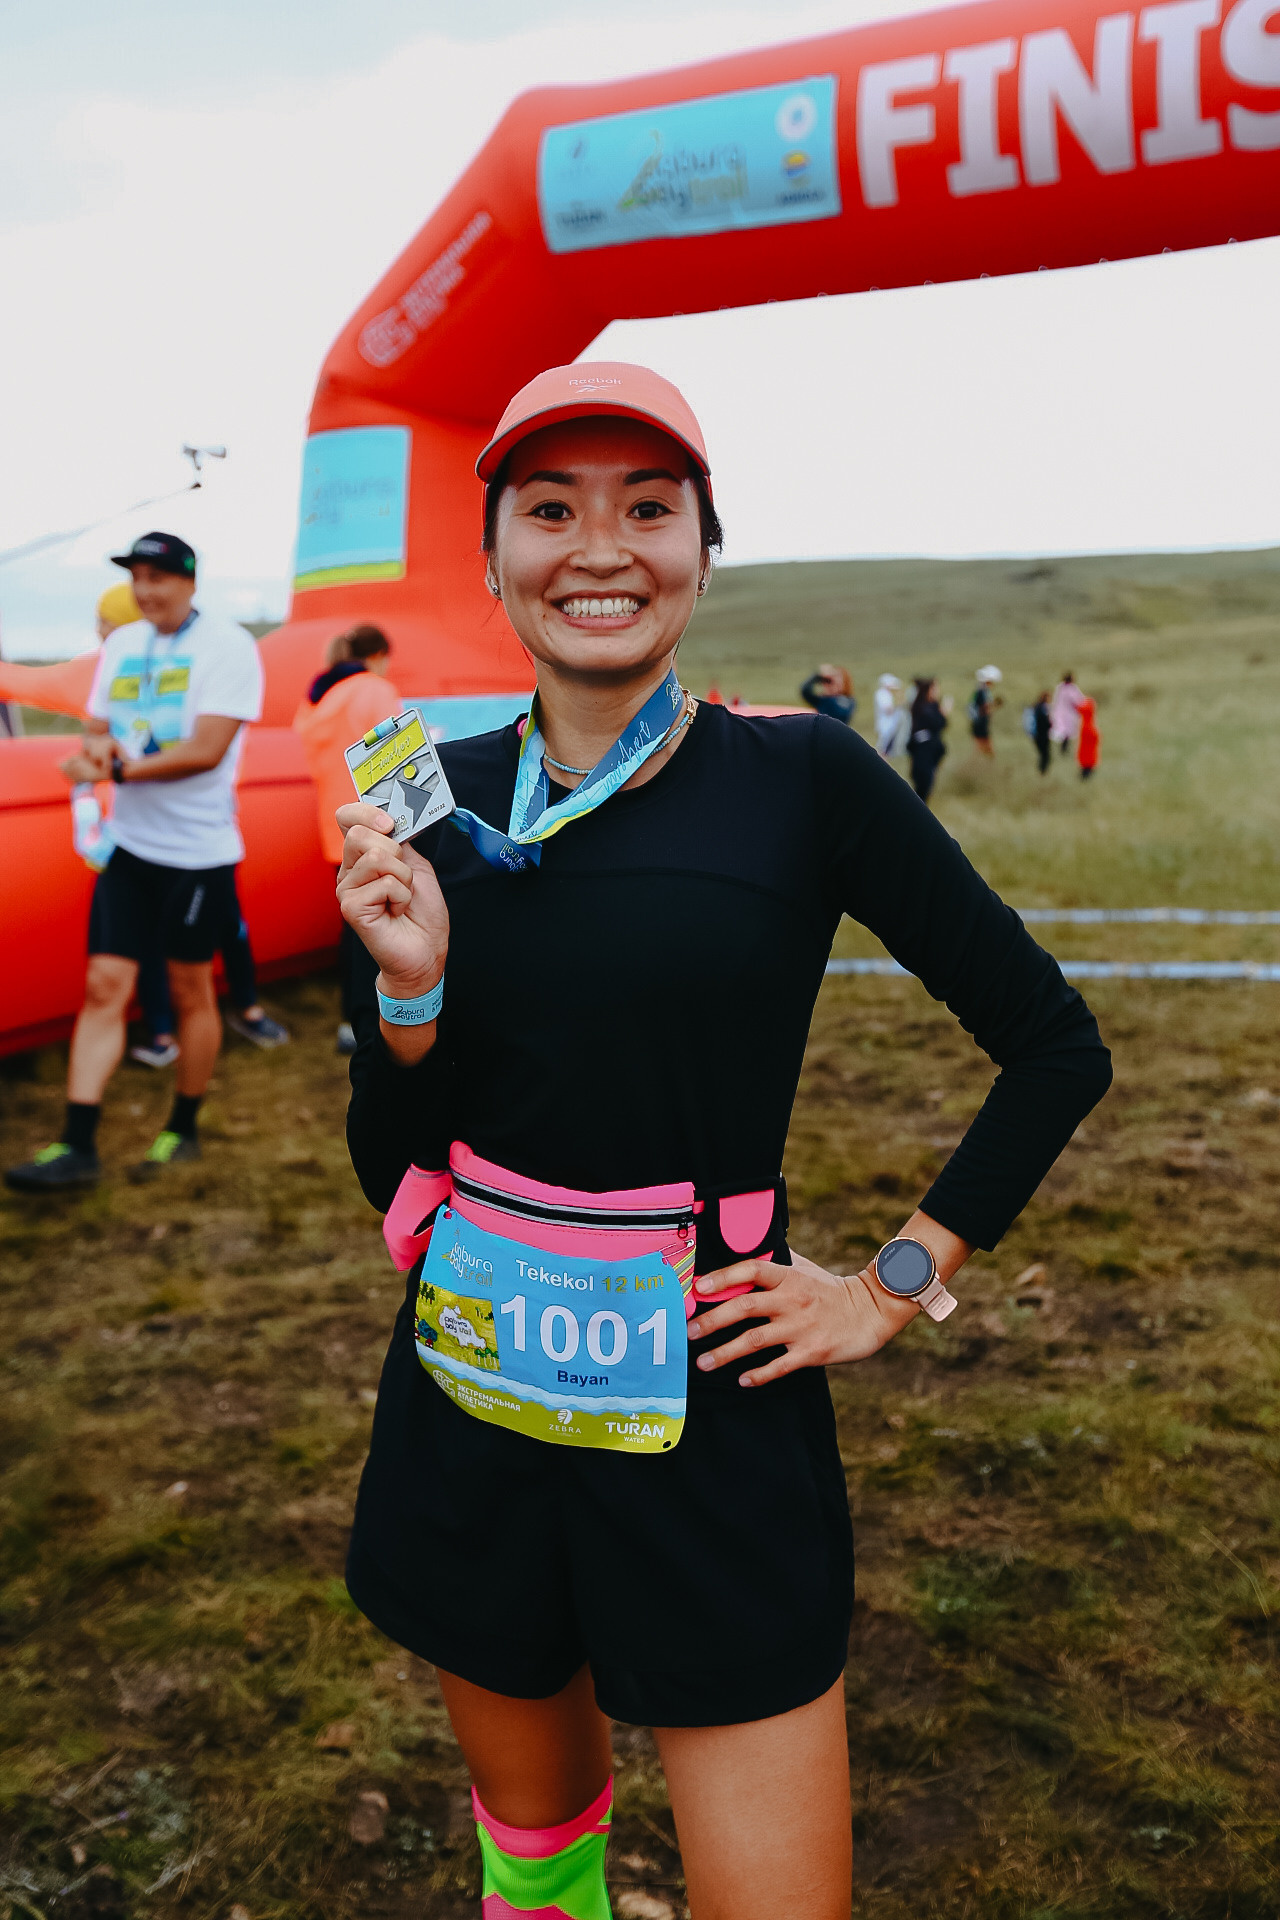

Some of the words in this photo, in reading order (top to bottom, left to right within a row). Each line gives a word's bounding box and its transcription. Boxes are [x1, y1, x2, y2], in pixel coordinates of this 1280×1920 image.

[515, 1258, 594, 1291] Tekekol
[602, 1276, 628, 1293] 12
[635, 1273, 665, 1292] km
[500, 1294, 667, 1366] 1001
[557, 1370, 609, 1386] Bayan
[456, 1383, 521, 1412] ЭКСТРЕМАЛЬНАЯ
[457, 1391, 494, 1411] АТЛЕТИКА
[548, 1424, 582, 1434] ZEBRA
[604, 1421, 666, 1439] TURAN
[623, 1436, 646, 1444] WATER
